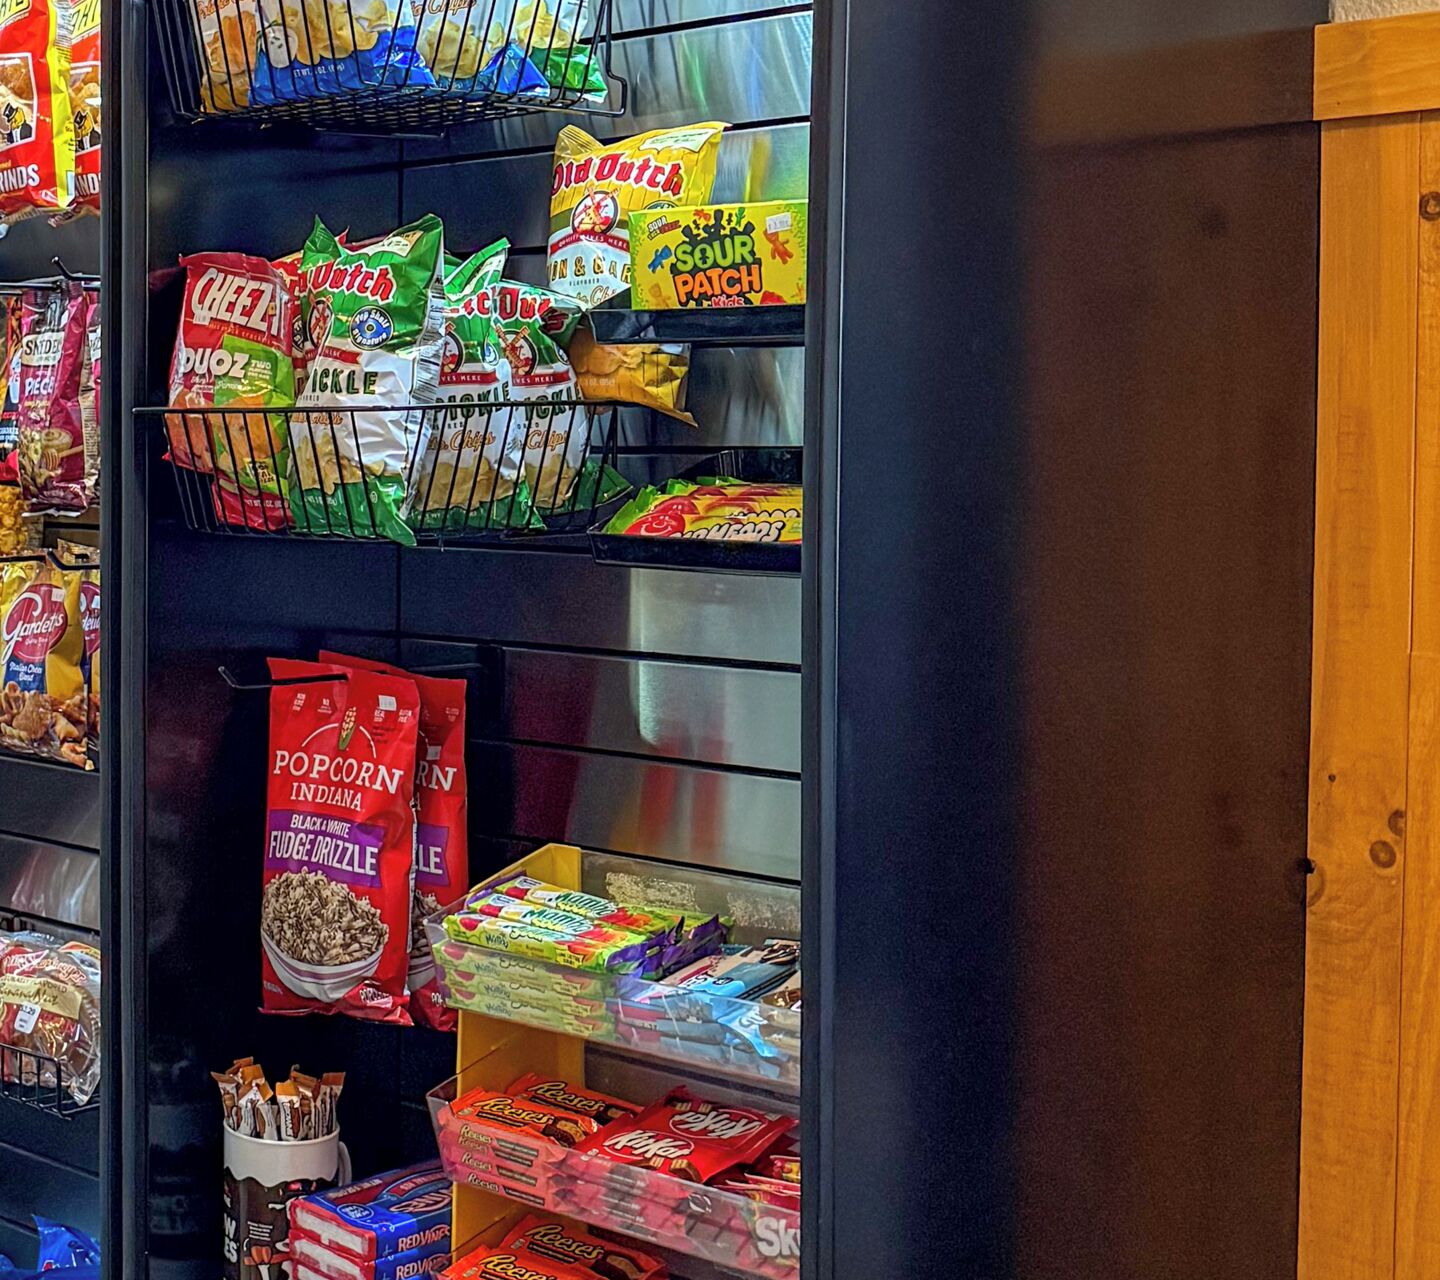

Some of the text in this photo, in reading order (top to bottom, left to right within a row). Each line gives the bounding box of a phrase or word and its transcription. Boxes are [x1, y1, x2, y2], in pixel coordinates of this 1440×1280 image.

[553, 152, 685, 196] Old Dutch
[574, 255, 586, 276] &
[674, 235, 754, 272] SOUR
[310, 260, 394, 302] Dutch
[674, 264, 761, 303] PATCH
[711, 294, 745, 307] Kids
[369, 308, 391, 329] Shelf
[311, 368, 379, 395] ICKLE
[272, 749, 404, 795] POPCORN
[290, 782, 363, 812] INDIANA
[290, 814, 321, 831] BLACK
[326, 819, 352, 839] WHITE
[268, 830, 379, 877] FUDGE DRIZZLE
[475, 1096, 554, 1126] Reese's
[527, 1079, 606, 1113] Reese's
[524, 1224, 605, 1261] Reese's
